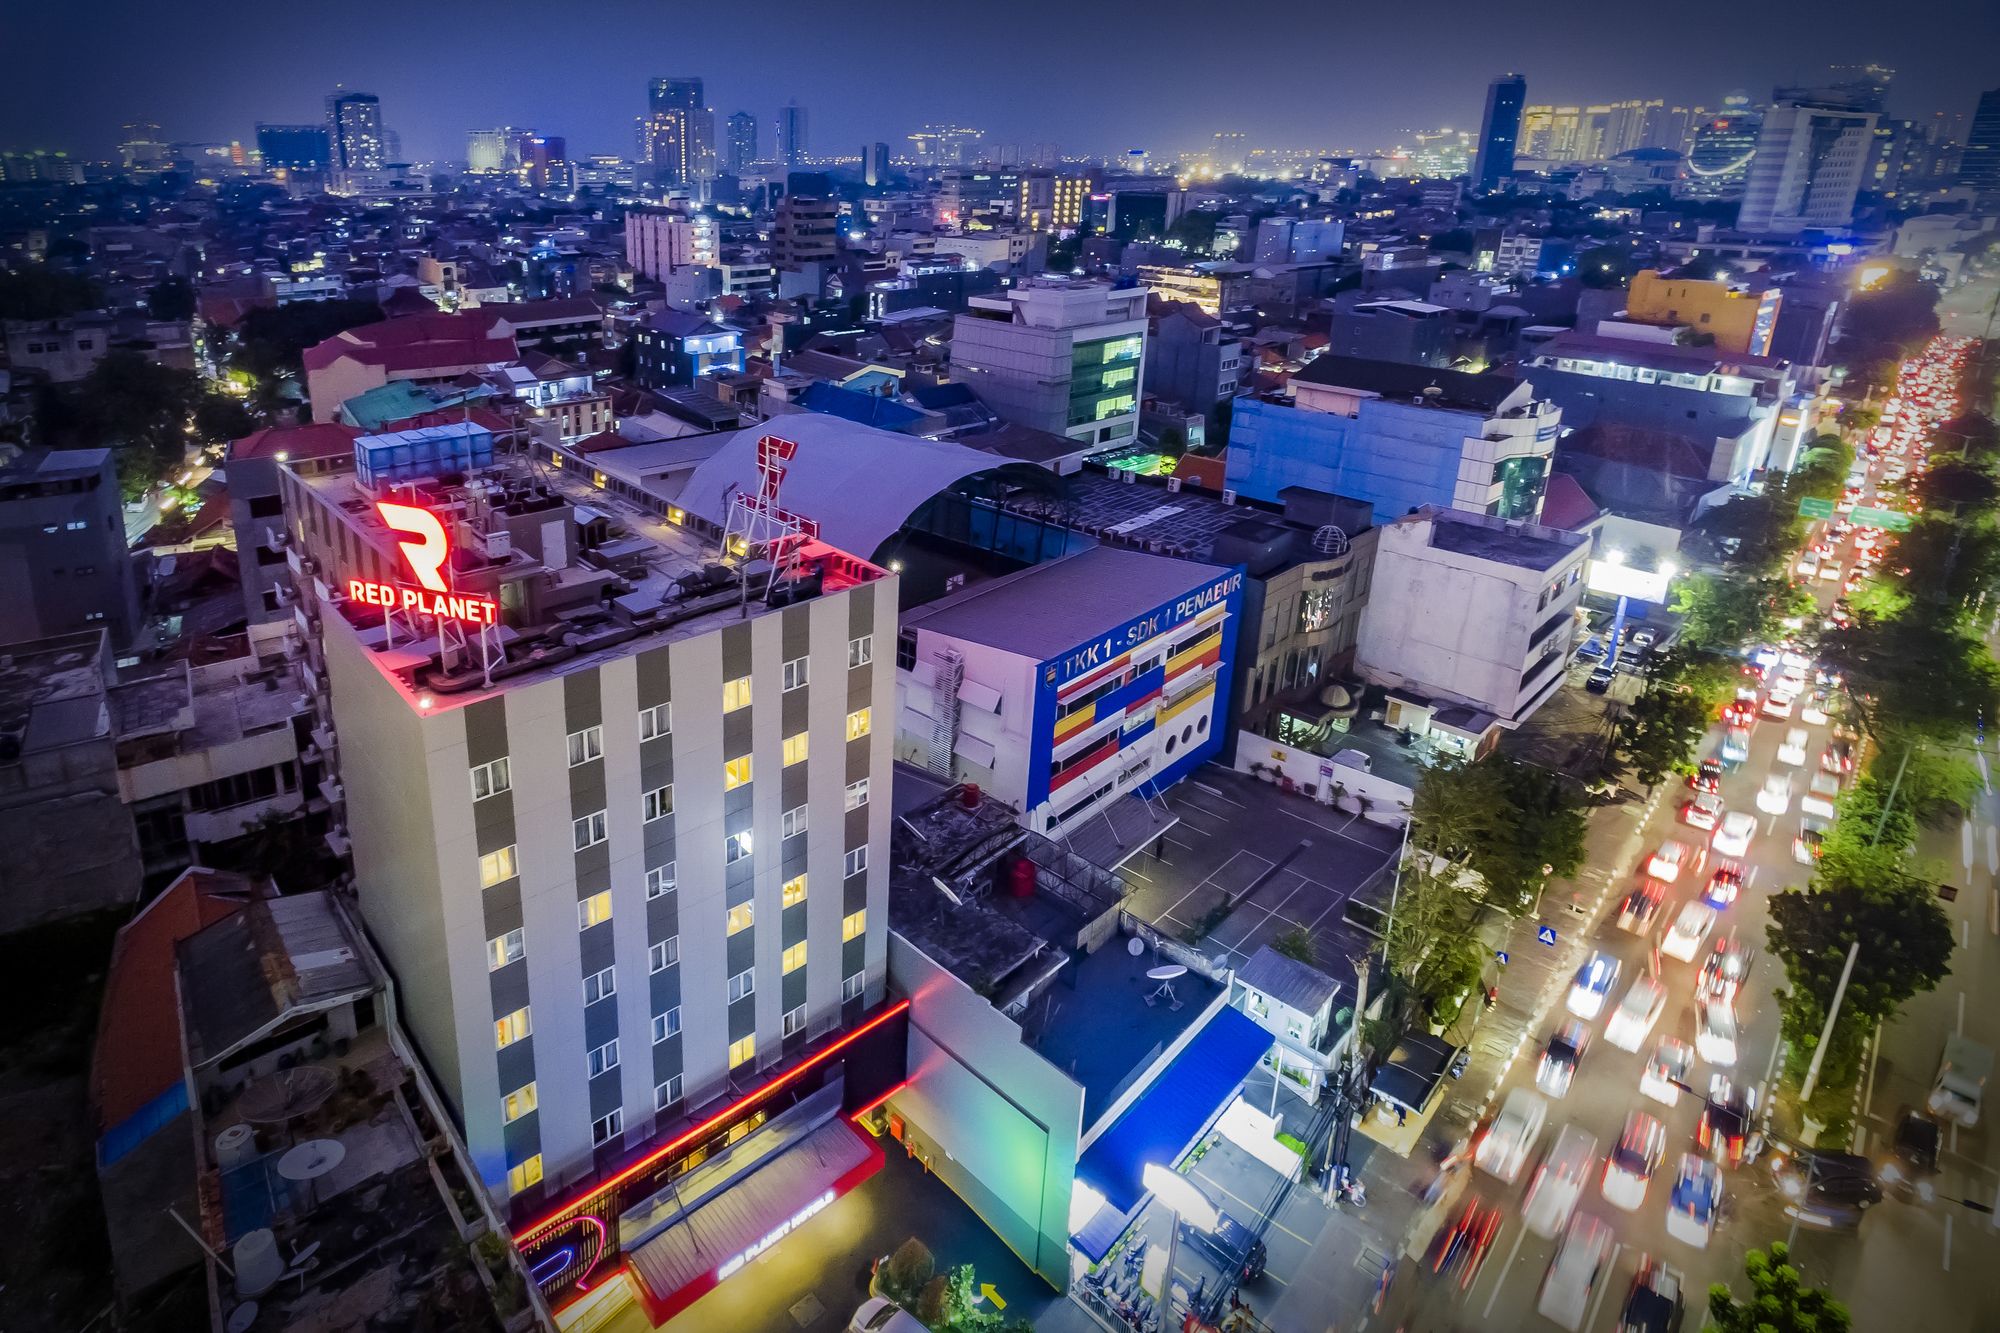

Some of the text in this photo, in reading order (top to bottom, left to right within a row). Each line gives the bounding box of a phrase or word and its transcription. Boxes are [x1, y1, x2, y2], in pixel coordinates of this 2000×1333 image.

[349, 580, 496, 624] RED PLANET
[1064, 643, 1100, 678] TKK
[1104, 638, 1111, 658] 1
[1126, 613, 1160, 646] SDK
[1164, 607, 1171, 628] 1
[1175, 573, 1241, 622] PENABUR
